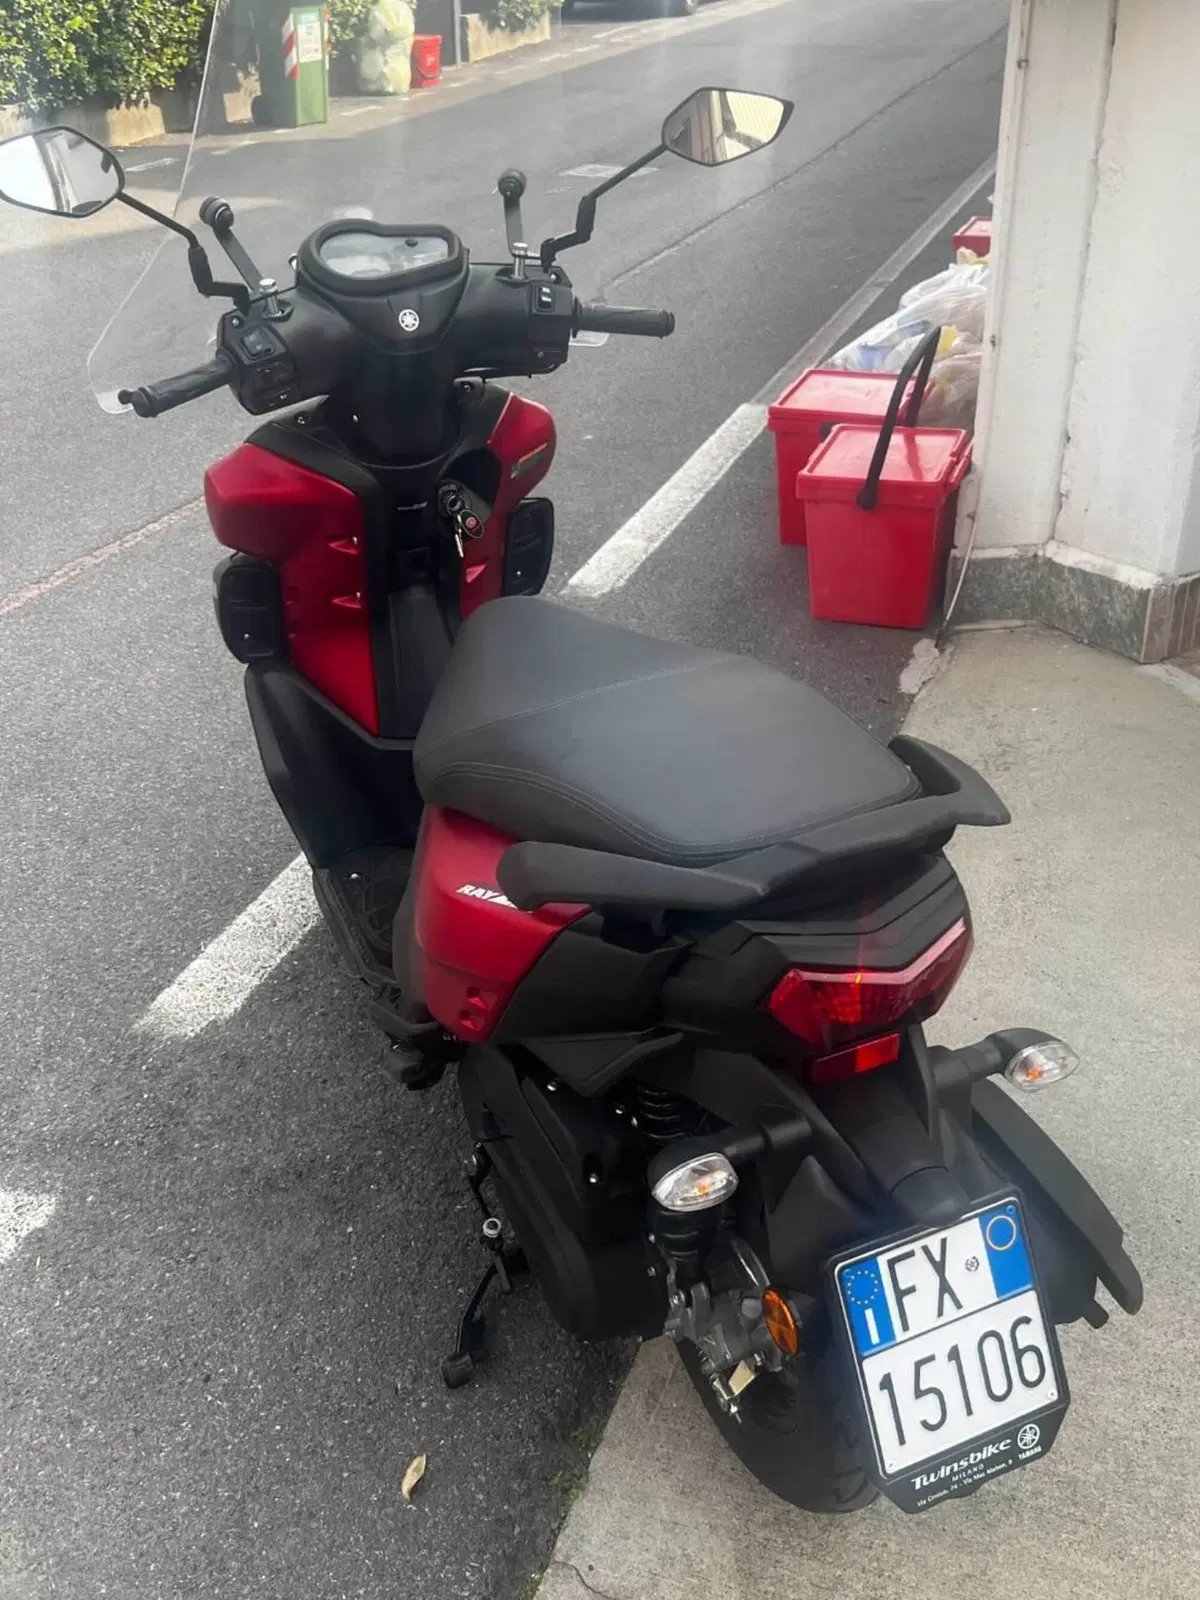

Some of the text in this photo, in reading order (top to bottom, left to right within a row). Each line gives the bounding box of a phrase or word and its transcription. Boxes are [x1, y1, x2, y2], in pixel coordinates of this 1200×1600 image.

[886, 1236, 963, 1332] FX
[878, 1315, 1046, 1446] 15106
[911, 1439, 1012, 1490] Twinsbike
[951, 1463, 985, 1482] MILANO
